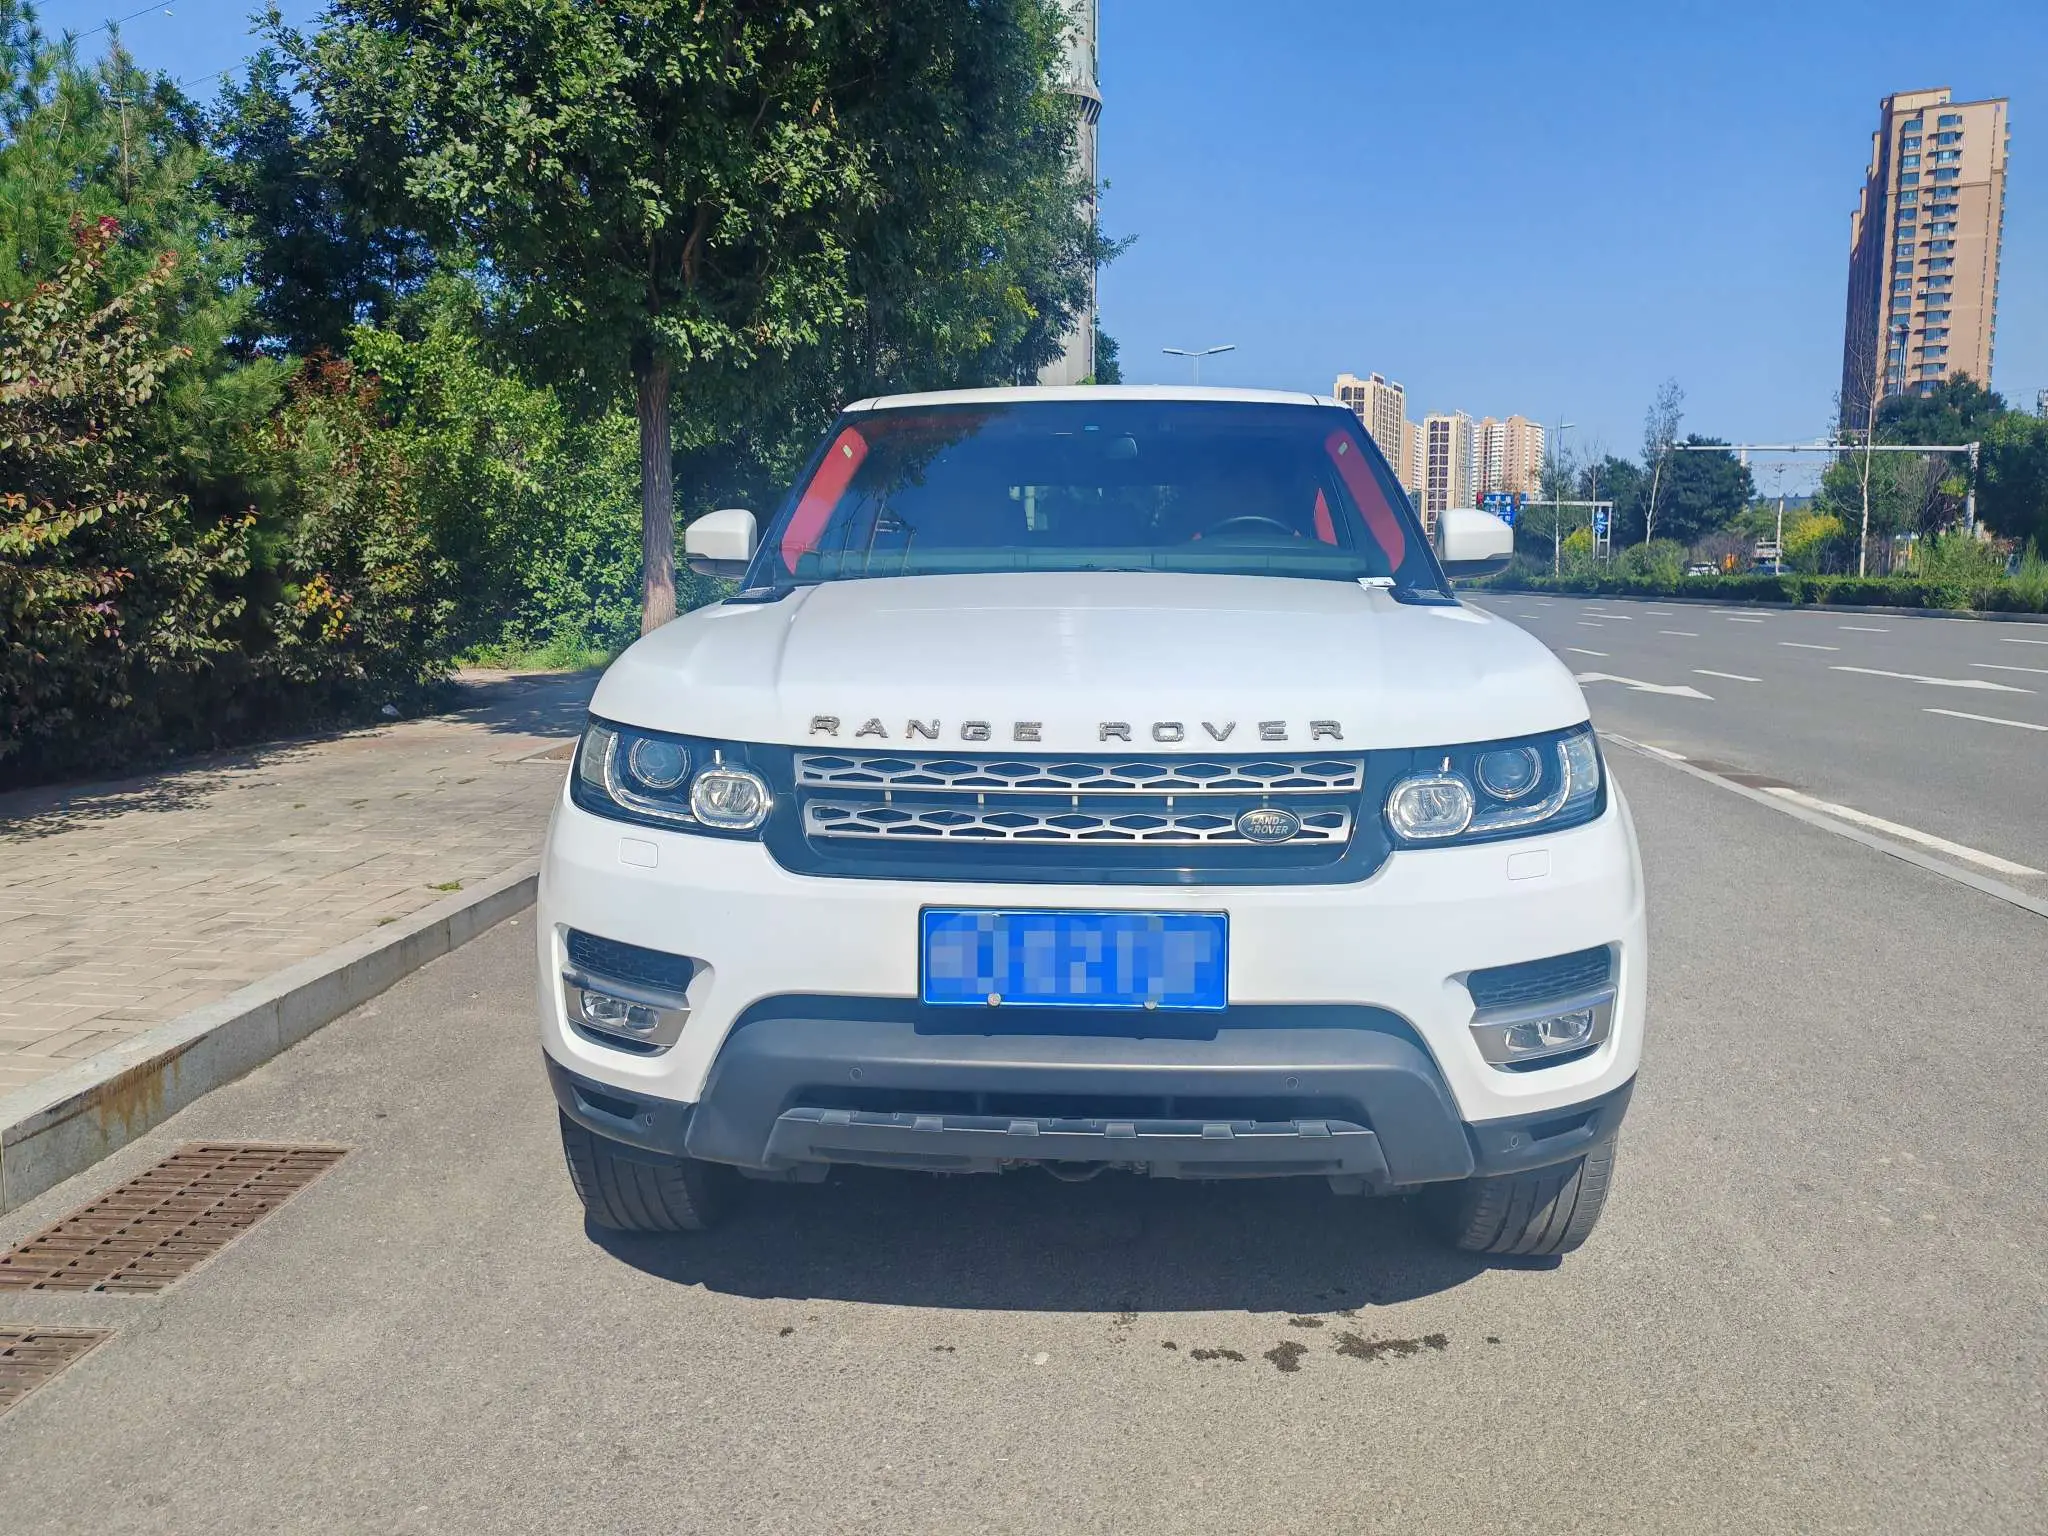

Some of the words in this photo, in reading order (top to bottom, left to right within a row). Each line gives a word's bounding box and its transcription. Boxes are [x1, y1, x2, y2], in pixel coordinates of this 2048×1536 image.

[808, 715, 1043, 742] RANGE
[1099, 719, 1344, 742] ROVER
[1250, 815, 1280, 825] LAND
[1253, 824, 1289, 834] ROVER
